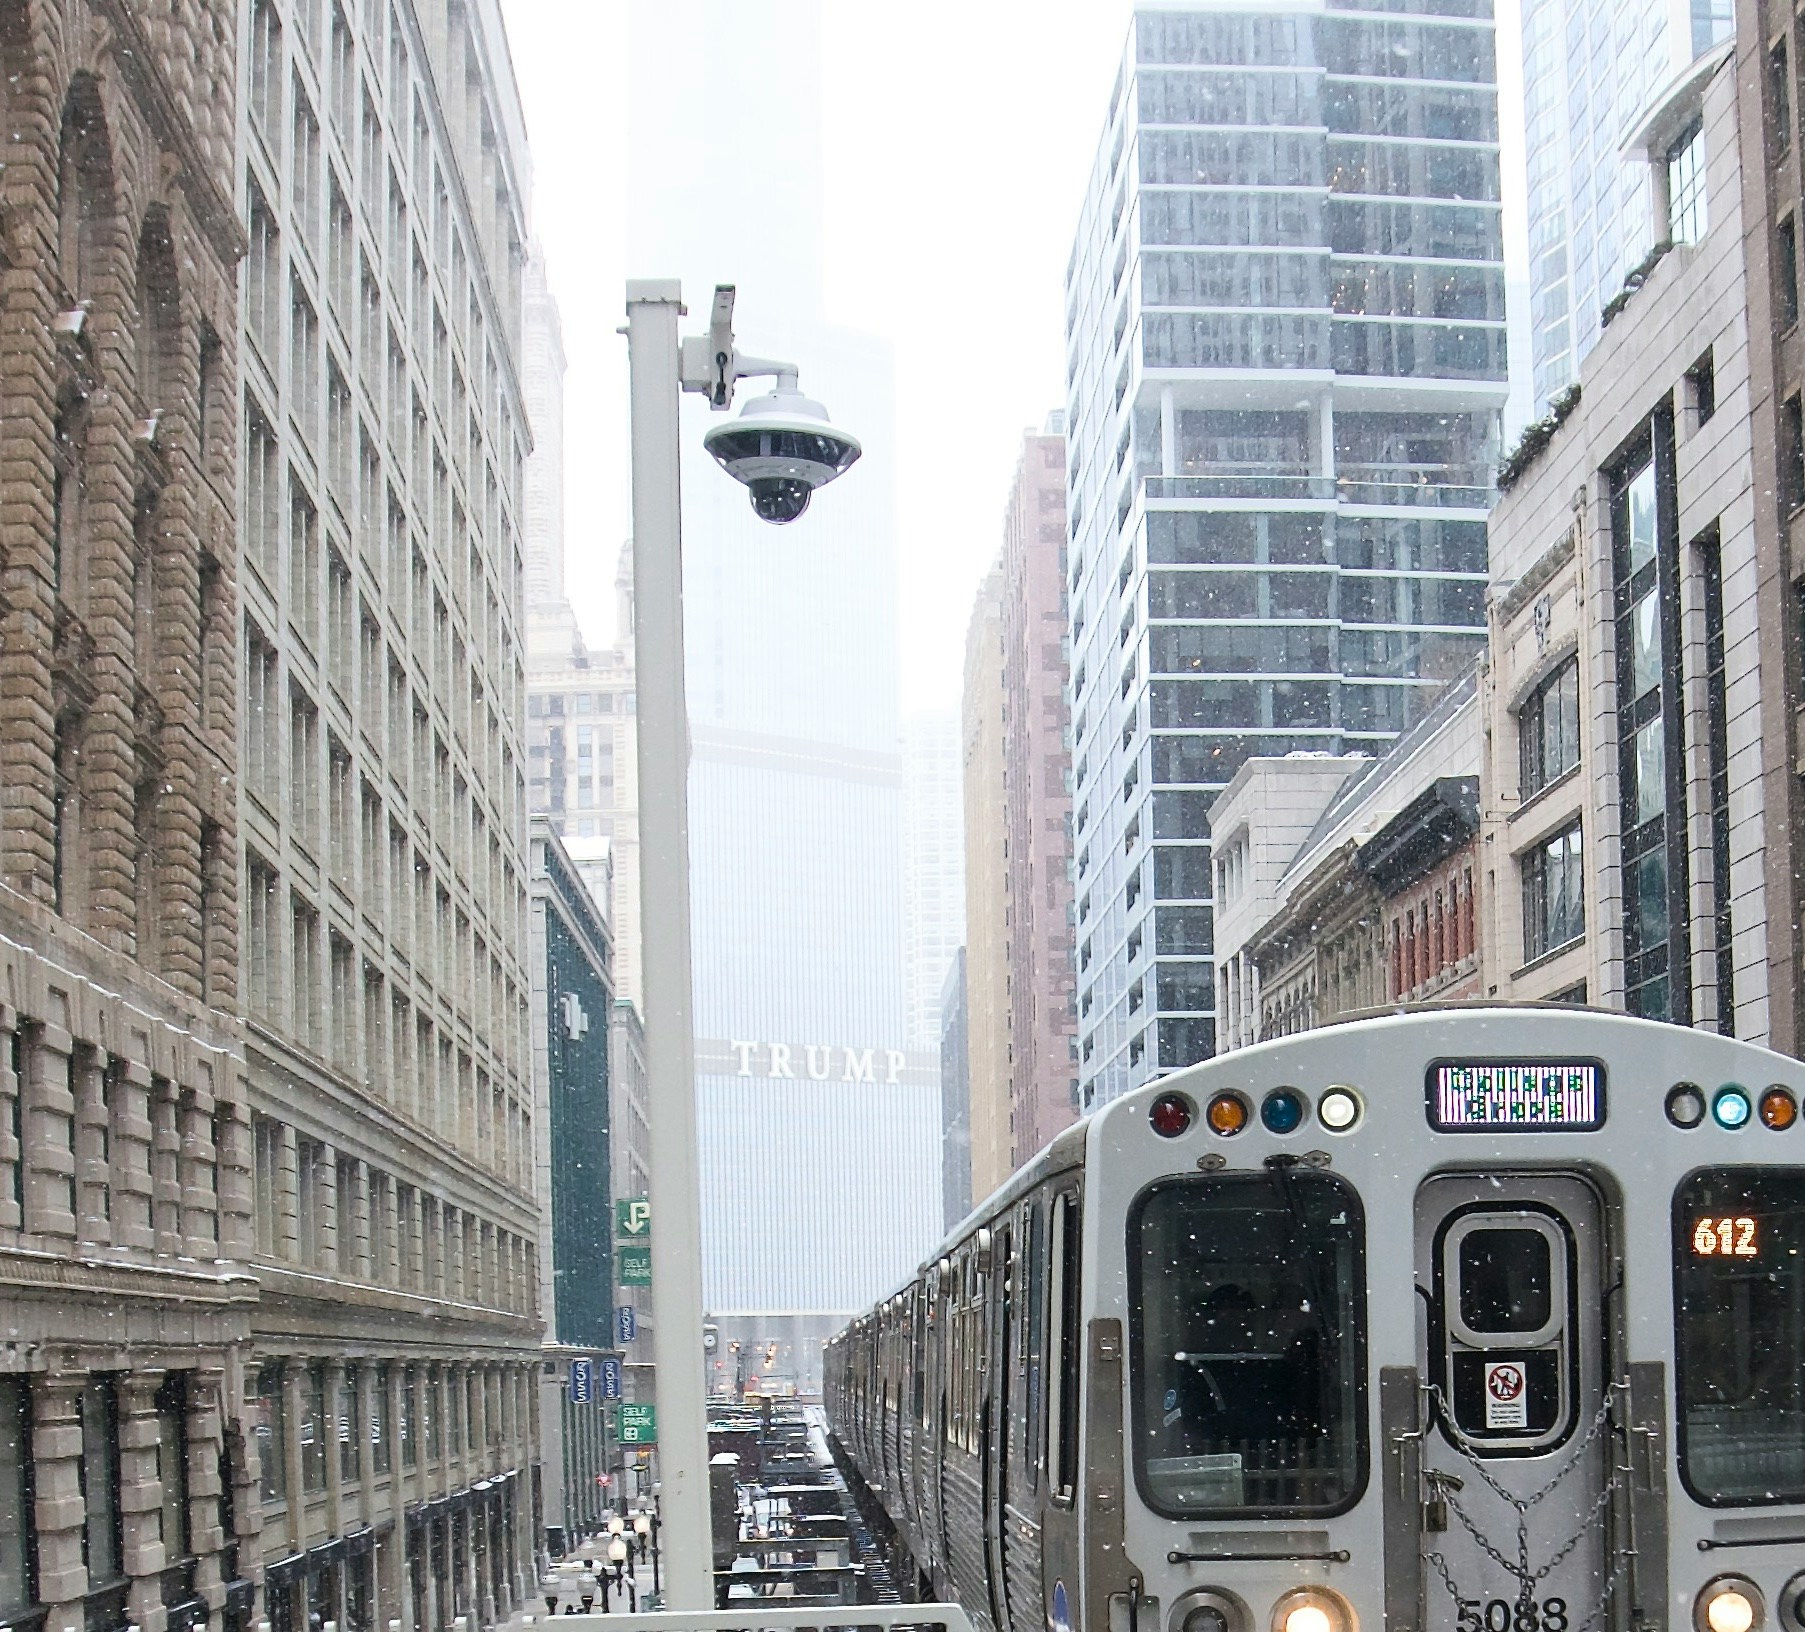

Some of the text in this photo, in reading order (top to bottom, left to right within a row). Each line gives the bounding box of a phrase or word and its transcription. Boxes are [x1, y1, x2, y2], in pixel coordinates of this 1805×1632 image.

[731, 1039, 906, 1084] TRUMP
[1694, 1217, 1758, 1254] 612
[624, 1258, 648, 1268] SELF
[624, 1268, 651, 1278] PARK
[575, 1361, 587, 1402] ROSS
[604, 1362, 615, 1399] ROSS
[623, 1407, 648, 1417] SELF
[623, 1416, 651, 1426] PARK
